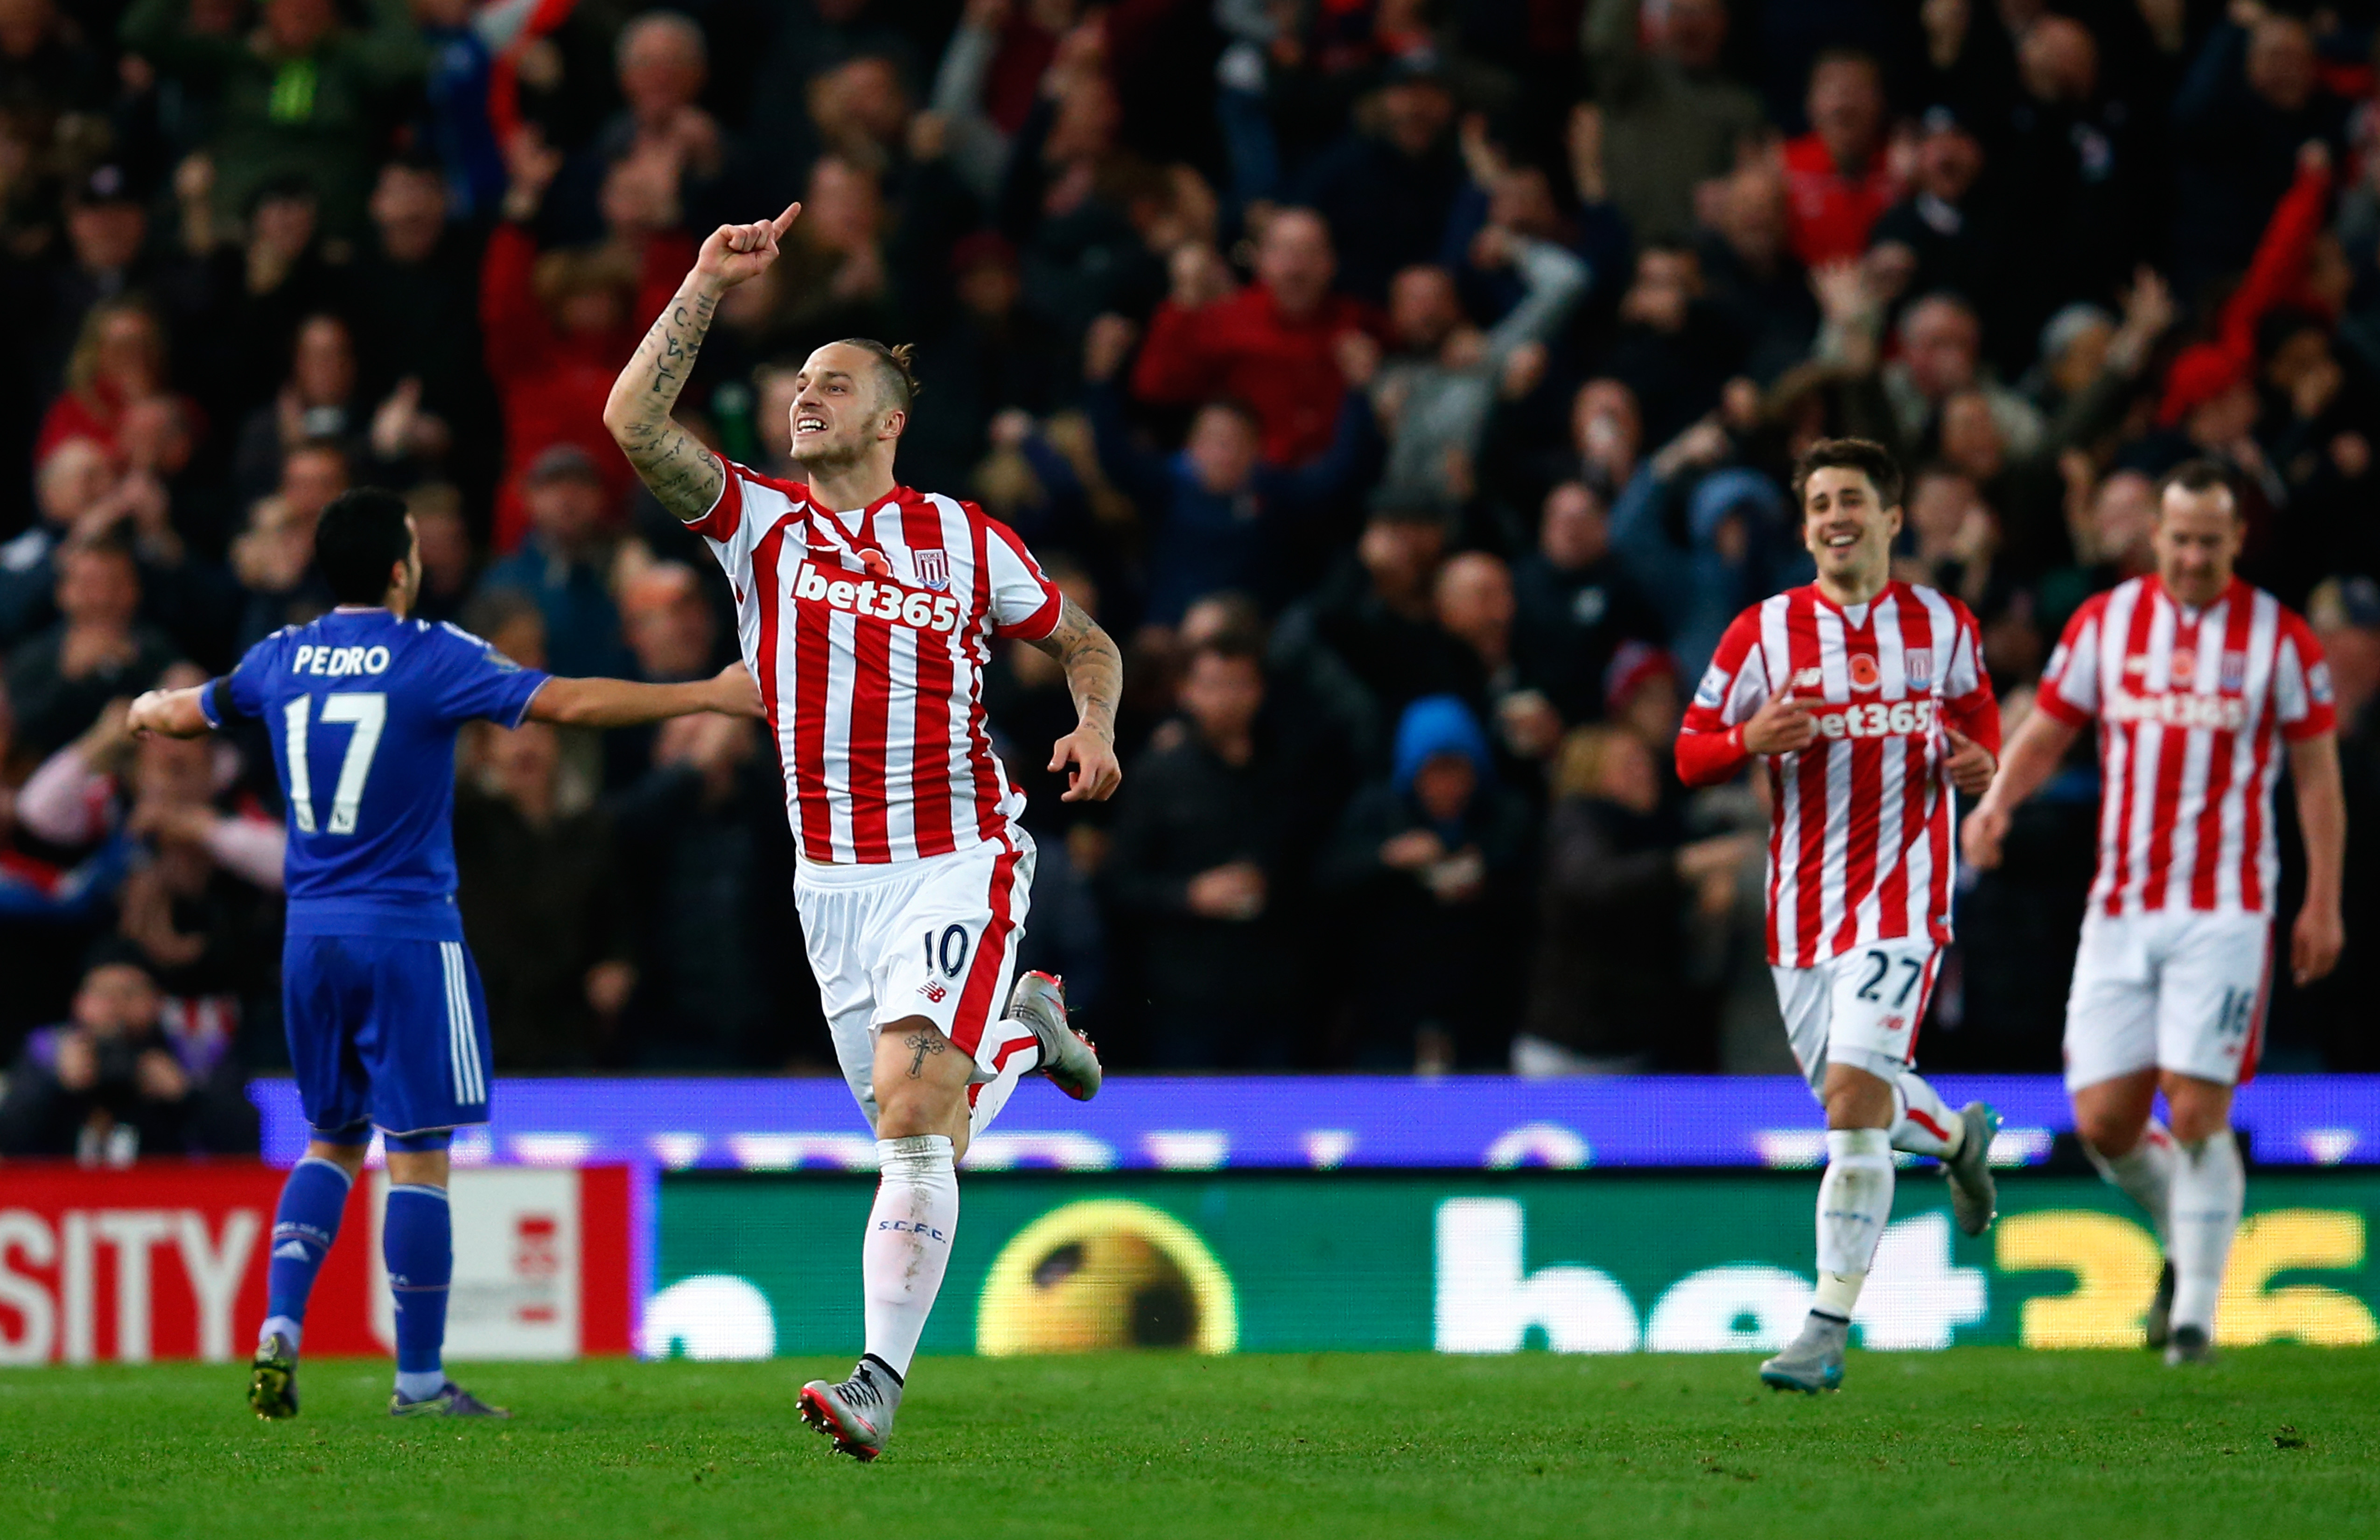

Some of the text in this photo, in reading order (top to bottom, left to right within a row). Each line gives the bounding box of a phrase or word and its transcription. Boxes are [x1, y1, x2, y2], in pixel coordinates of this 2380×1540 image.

[795, 562, 956, 631] bet365
[293, 645, 390, 676] PEDRO
[284, 693, 387, 834] 17
[922, 921, 970, 980] 10
[1856, 949, 1922, 1009] 27
[0, 1210, 260, 1360] SITY
